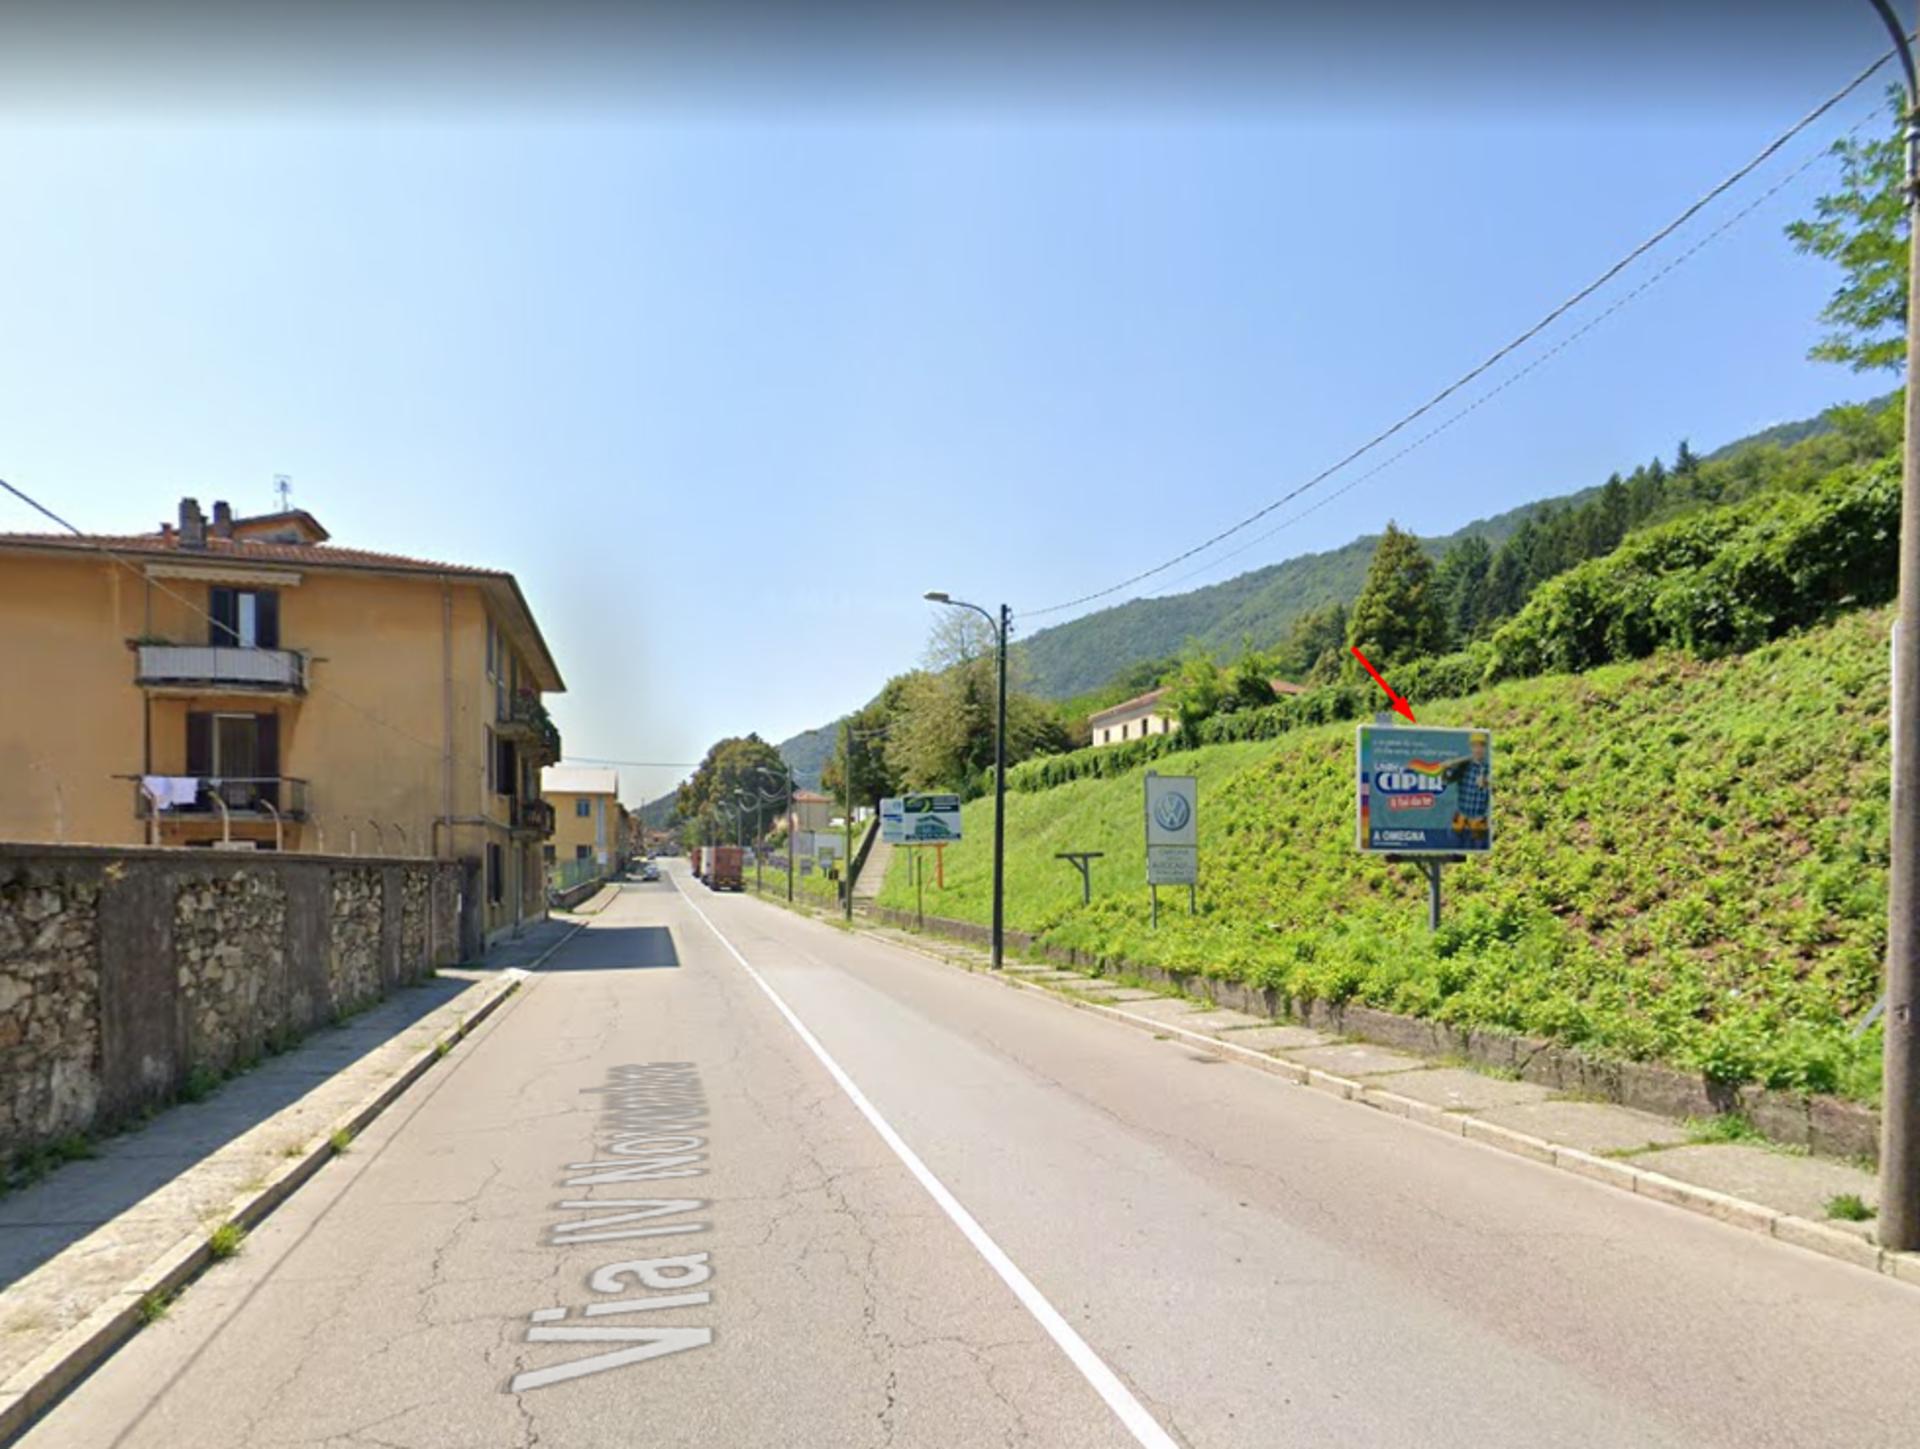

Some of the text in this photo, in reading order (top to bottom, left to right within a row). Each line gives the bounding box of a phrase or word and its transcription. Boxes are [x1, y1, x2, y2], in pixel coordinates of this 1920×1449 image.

[1377, 772, 1443, 791] CIPIR
[1372, 831, 1426, 841] A OMEGNA
